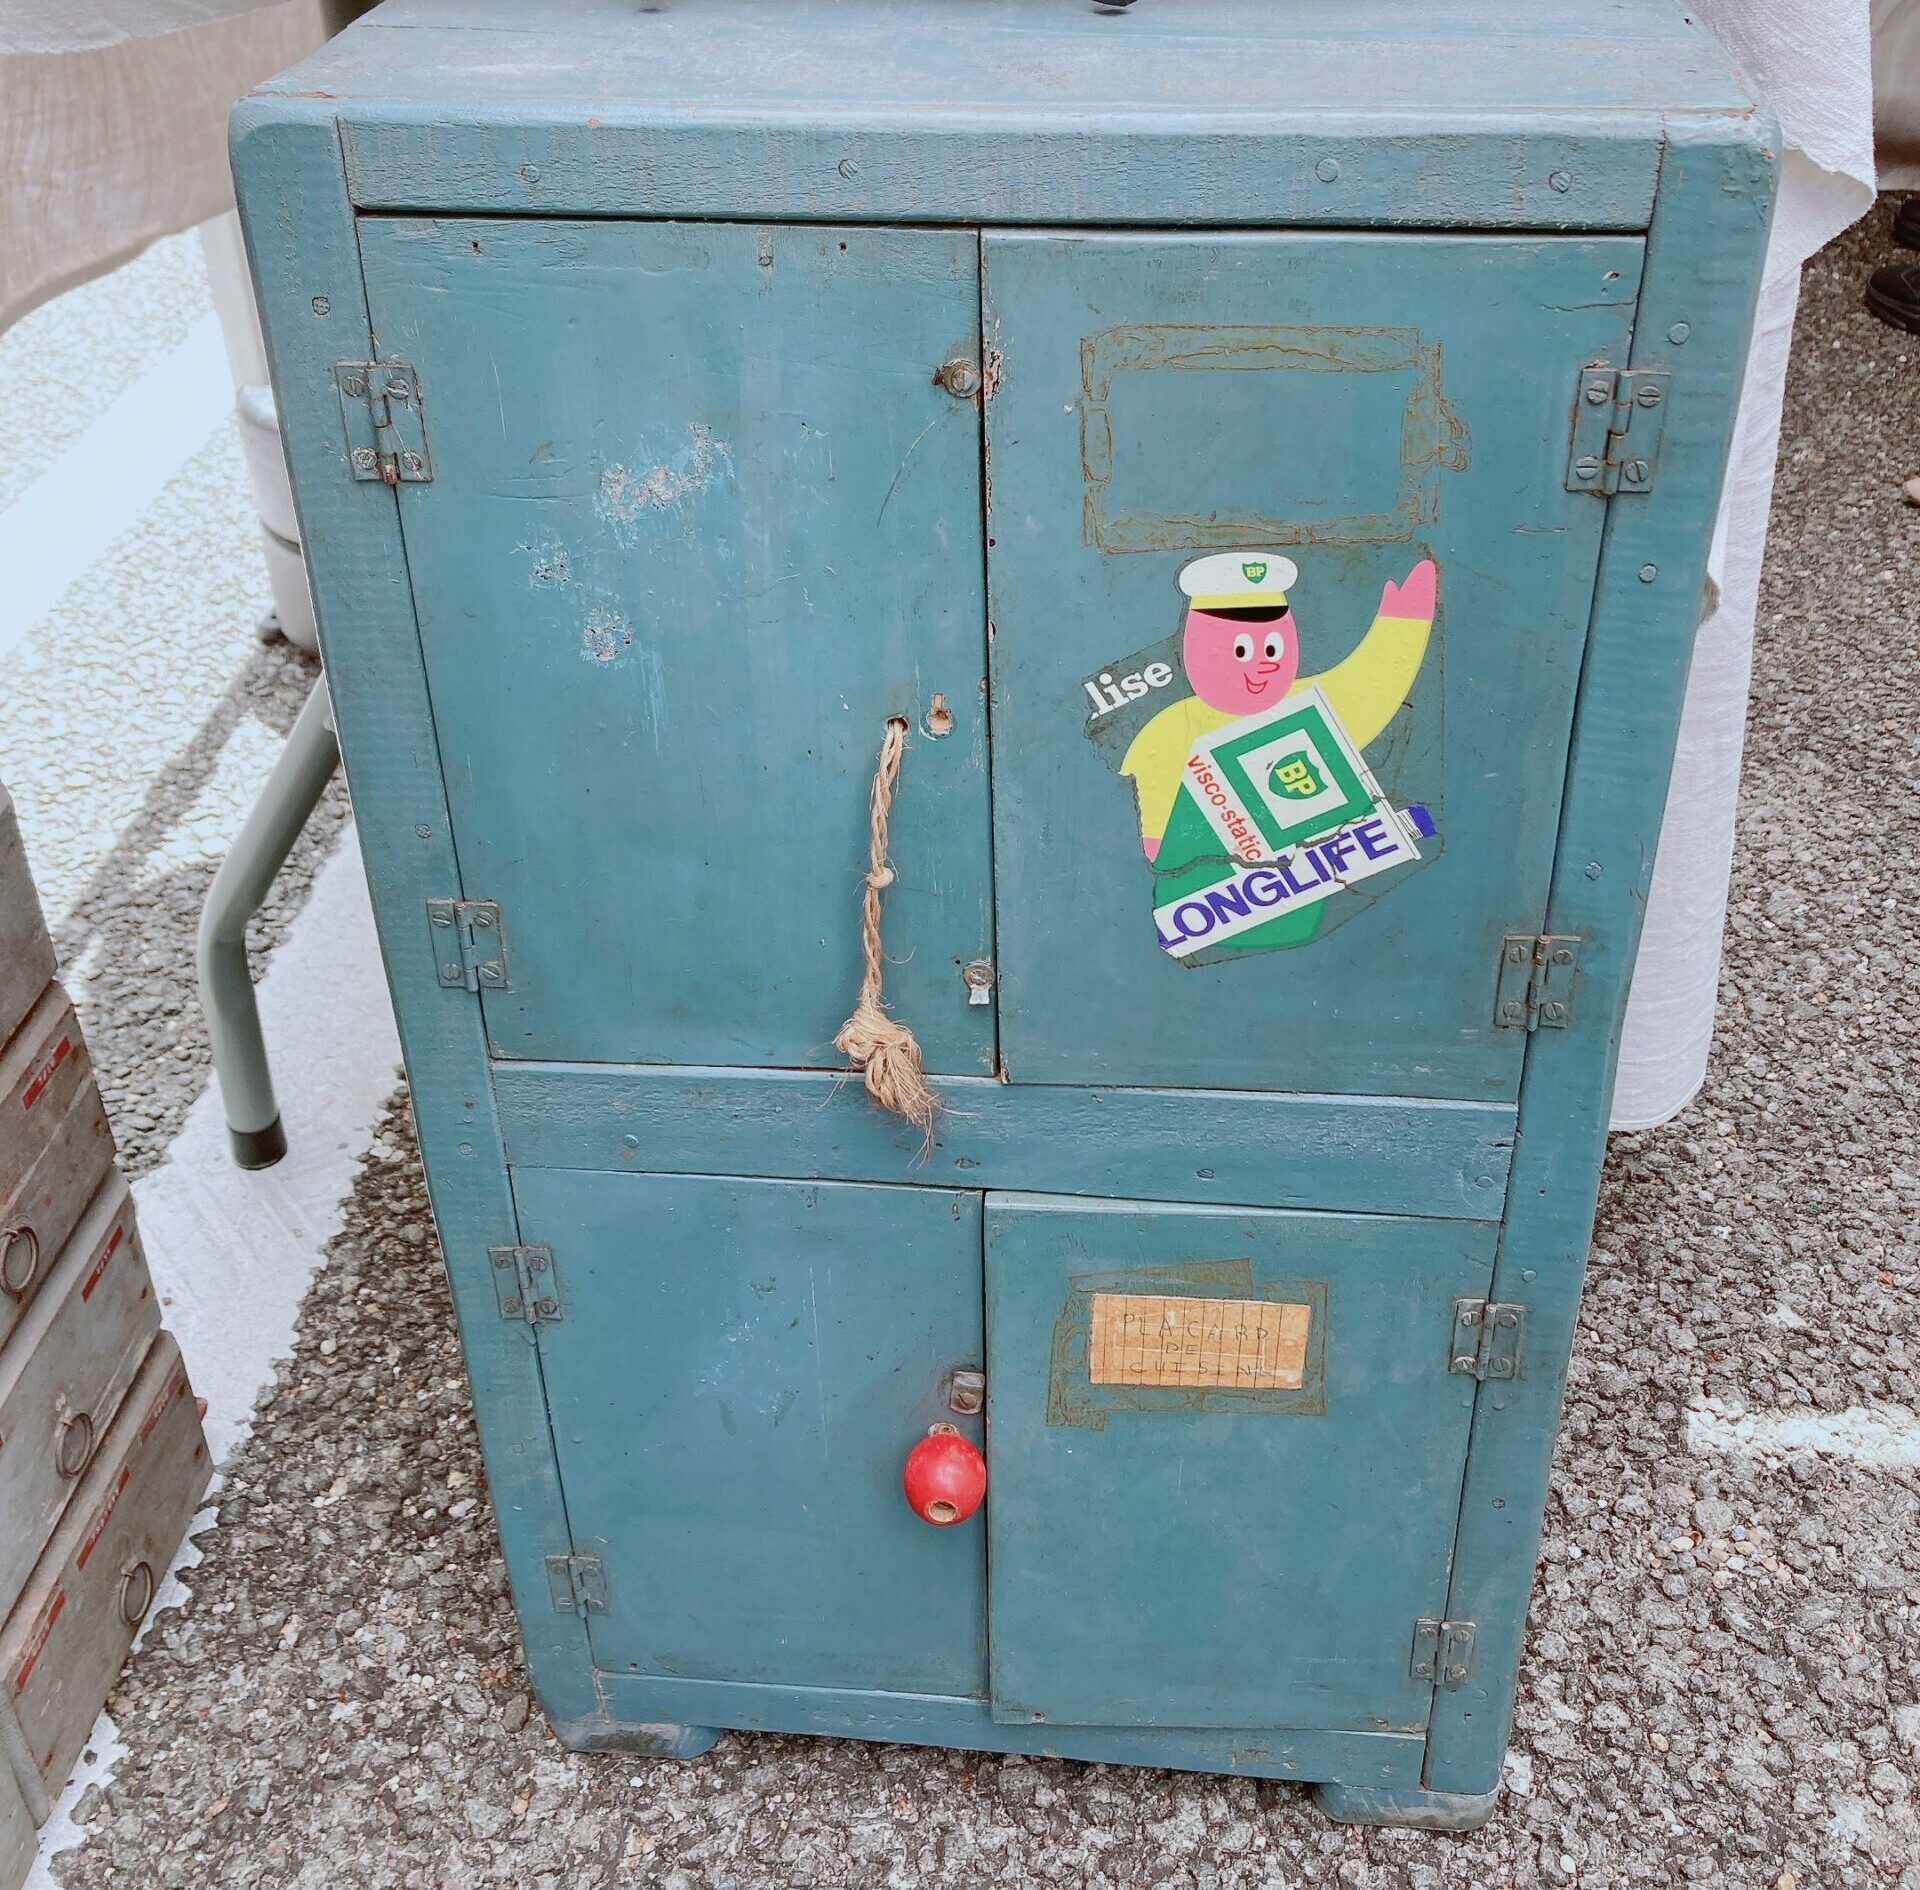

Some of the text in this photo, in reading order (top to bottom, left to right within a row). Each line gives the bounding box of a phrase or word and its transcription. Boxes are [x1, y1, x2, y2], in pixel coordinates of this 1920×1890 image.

[1246, 566, 1265, 578] BP
[1083, 662, 1173, 720] lise
[1275, 758, 1318, 796] BP
[1186, 754, 1262, 862] visco-static
[1156, 818, 1399, 949] LONGLIFE
[1123, 1312, 1269, 1341] PLACARD
[1165, 1342, 1197, 1355] DE
